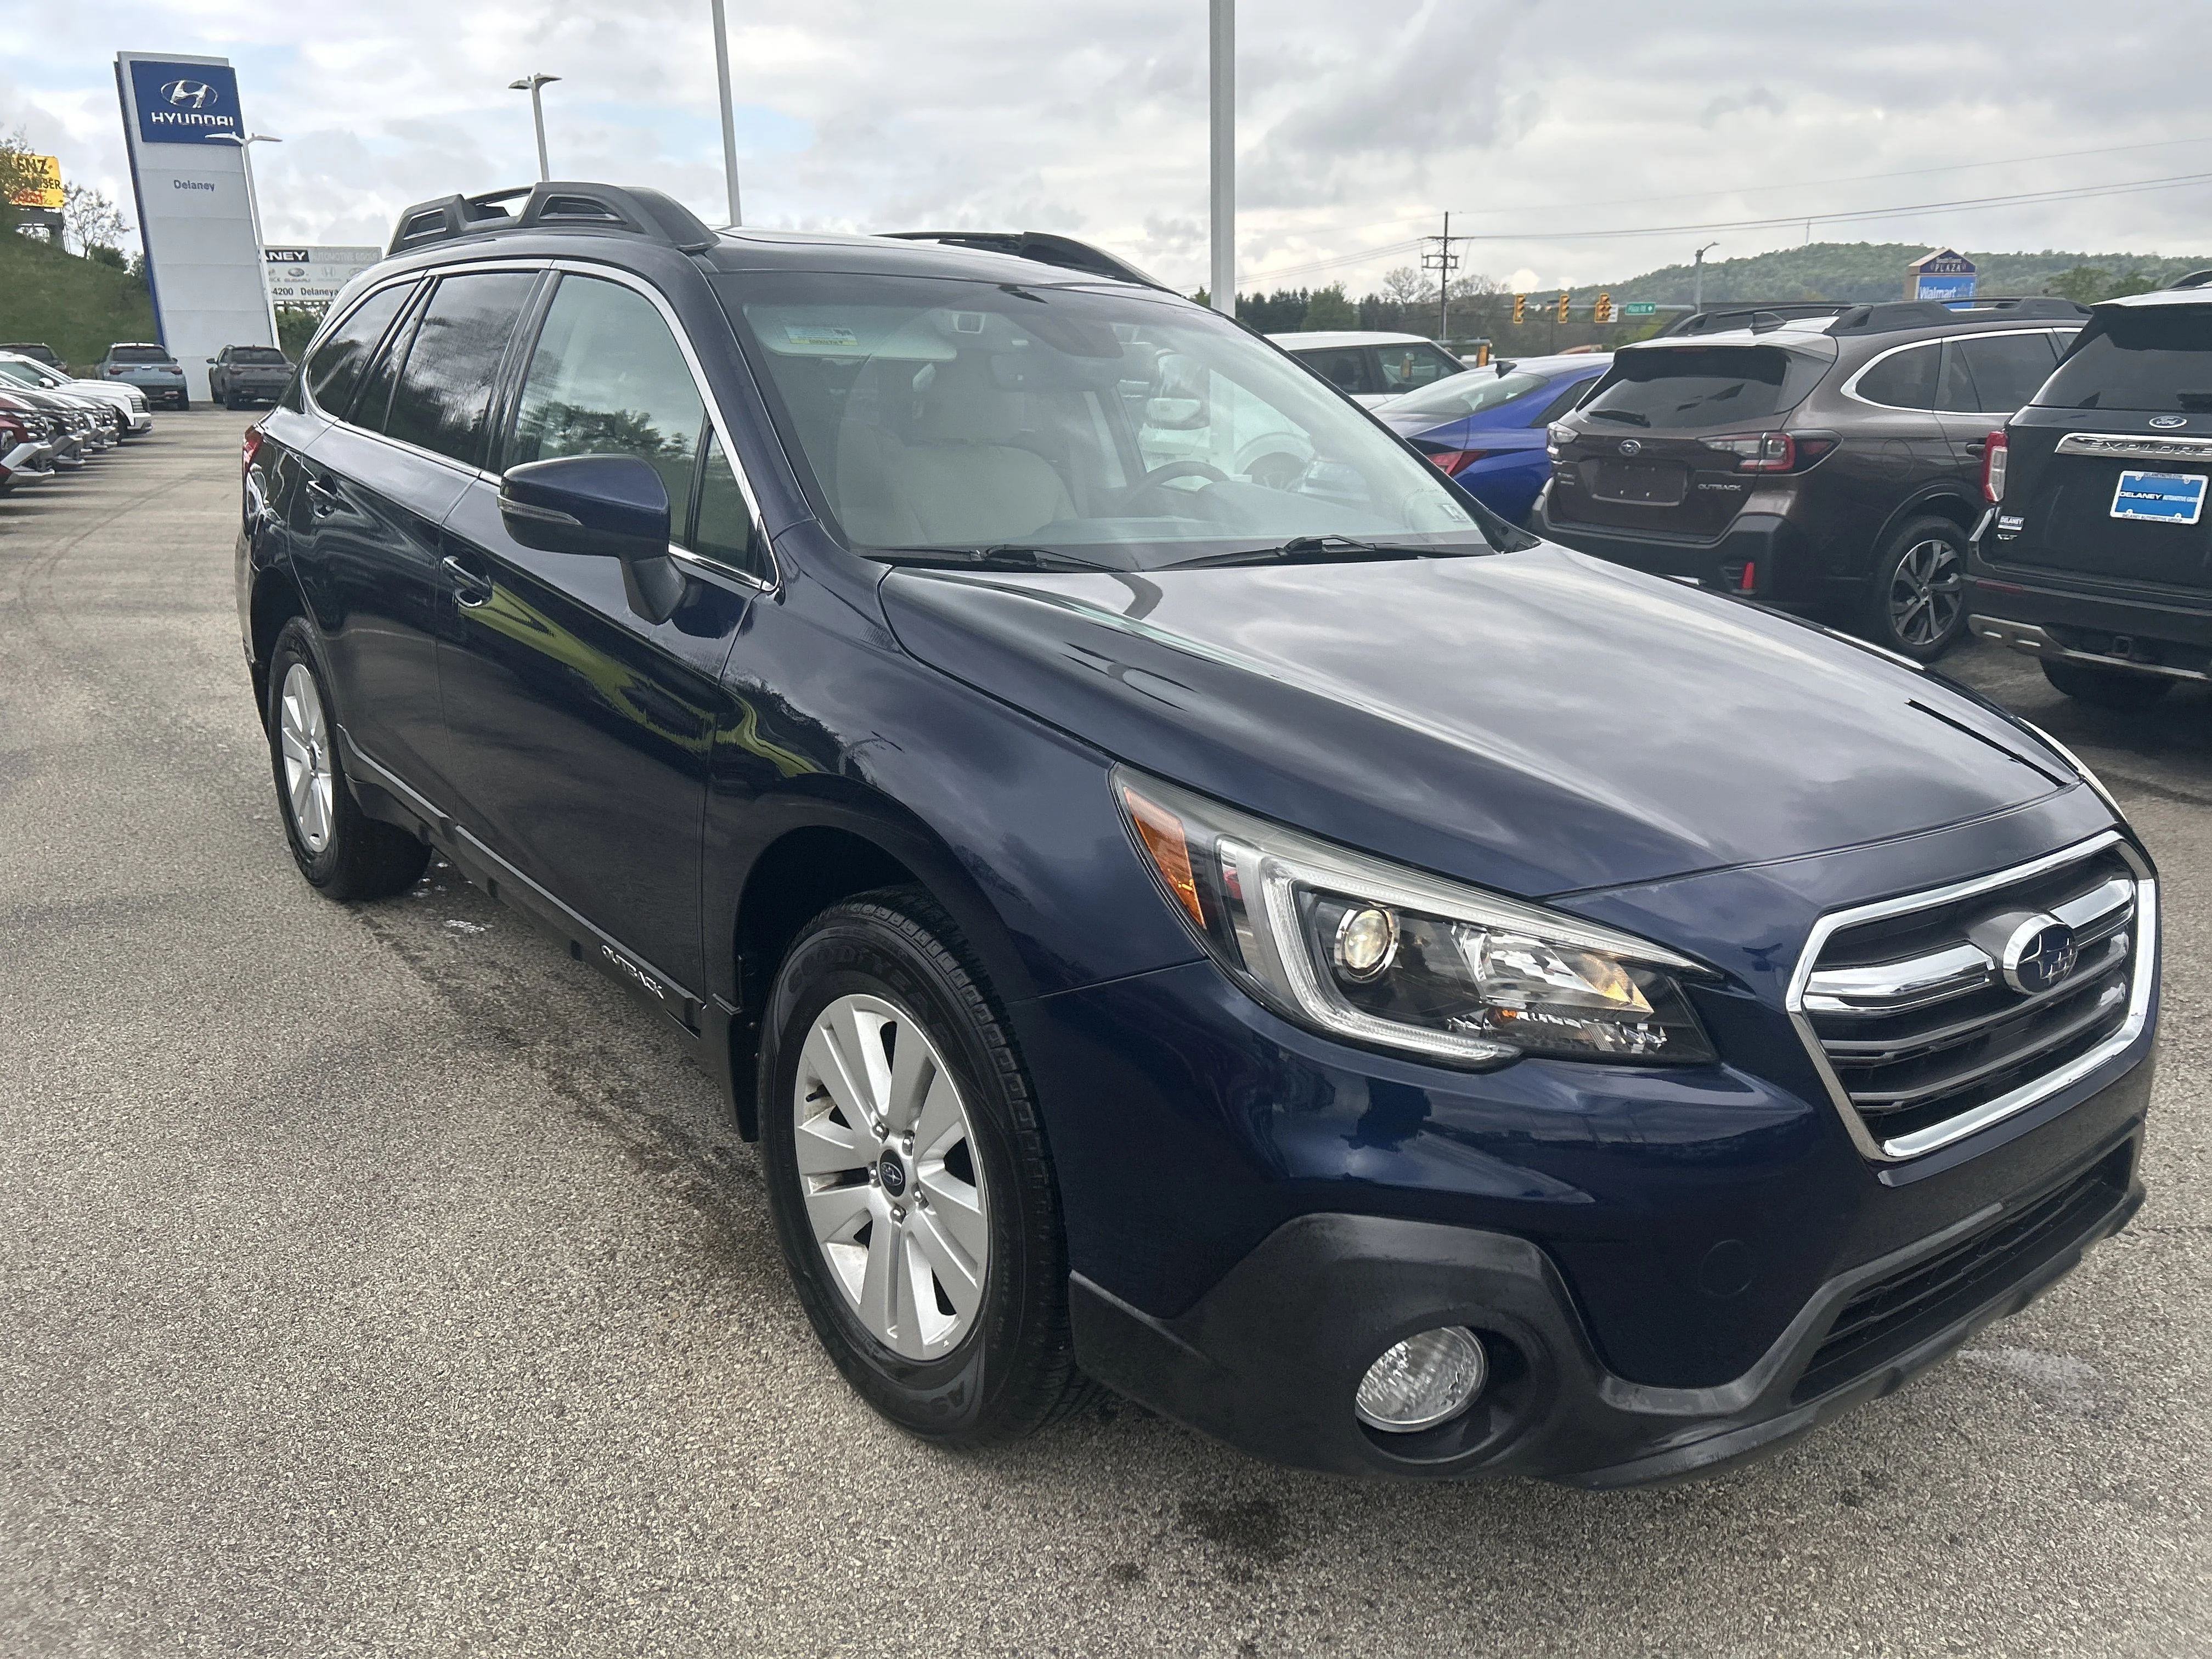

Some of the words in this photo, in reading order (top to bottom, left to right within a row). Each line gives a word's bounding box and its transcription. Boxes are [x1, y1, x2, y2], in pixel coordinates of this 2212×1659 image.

[151, 112, 233, 127] HYUNDAI
[173, 179, 215, 191] Delaney
[267, 251, 306, 261] NEY
[1935, 263, 1961, 272] PLAZA
[1920, 286, 1956, 299] Walmart
[2120, 491, 2162, 500] DELANEY
[787, 944, 955, 1052] GOODYEAR
